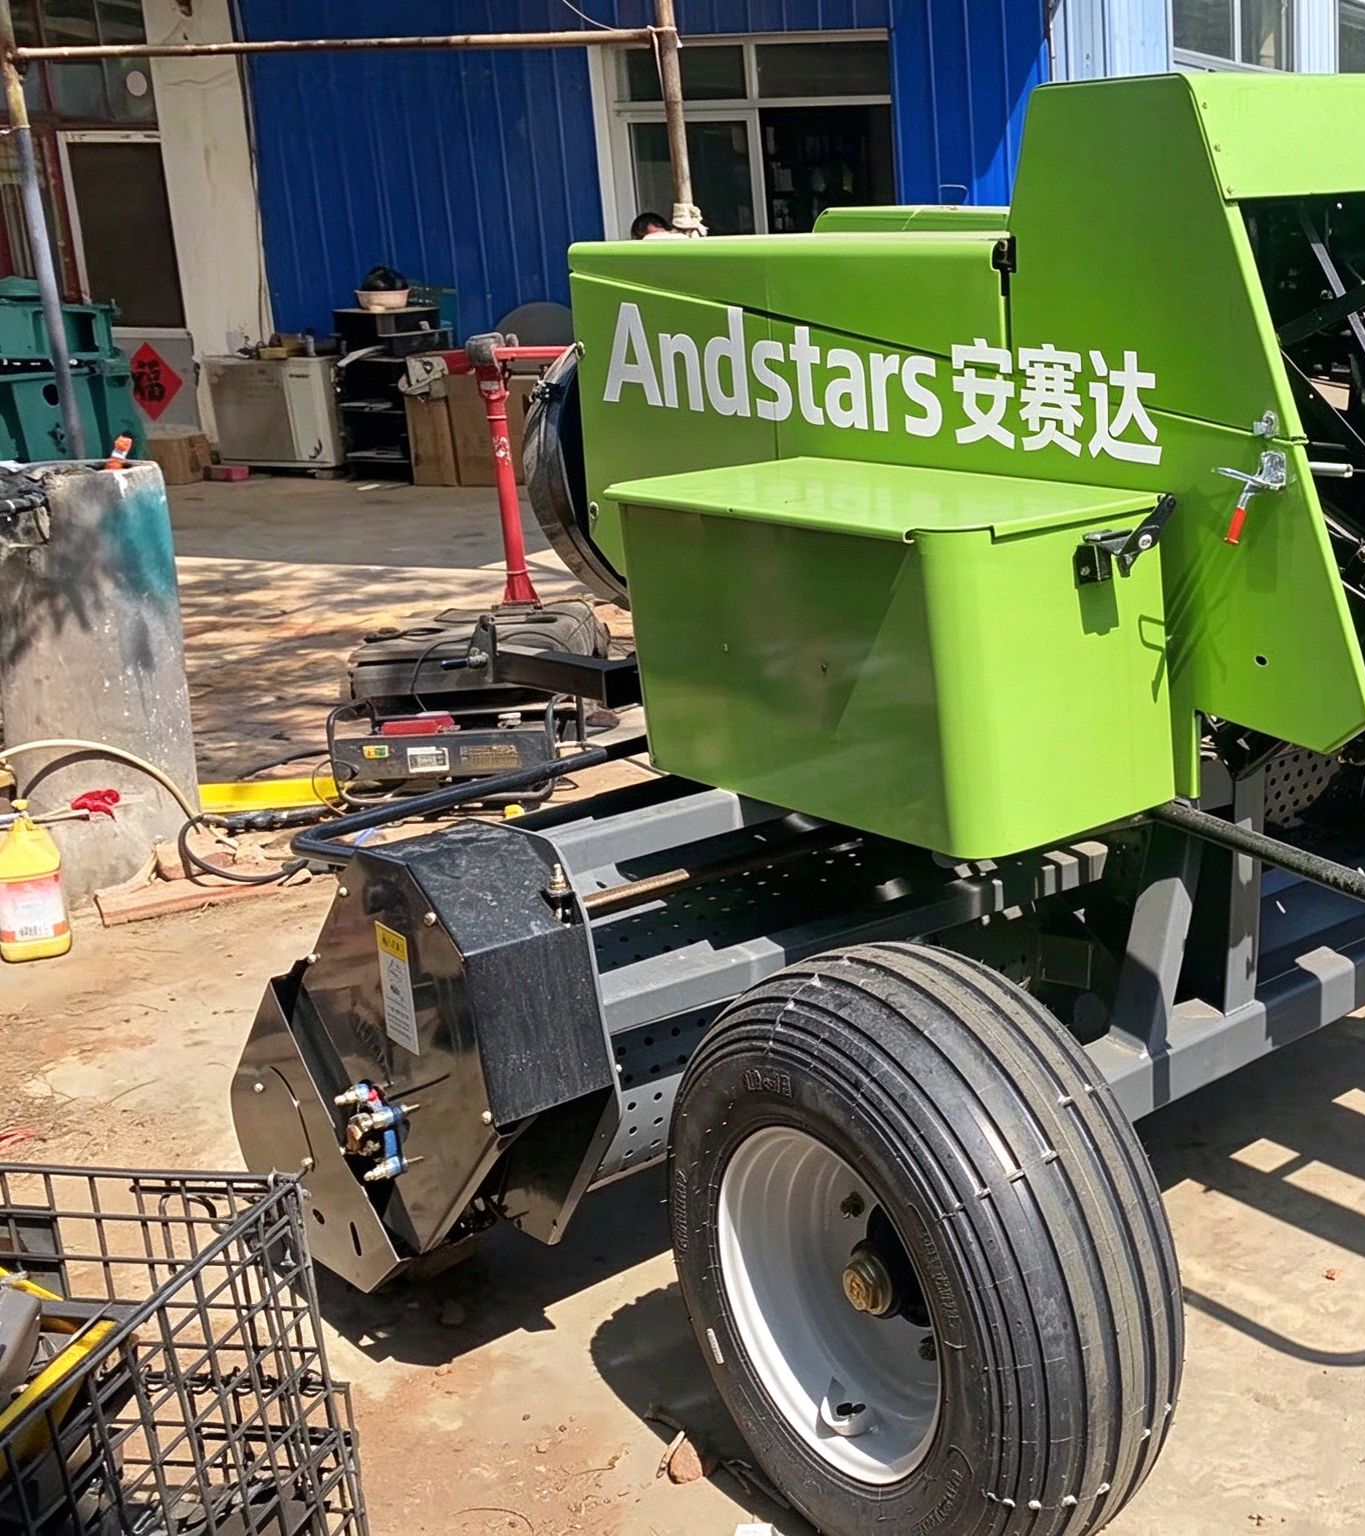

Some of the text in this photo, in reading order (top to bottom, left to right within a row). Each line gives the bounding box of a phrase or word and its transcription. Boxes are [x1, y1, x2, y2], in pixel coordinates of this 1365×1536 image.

[131, 359, 166, 402] 福
[603, 302, 943, 438] Andstars
[951, 338, 1163, 466] 安赛达
